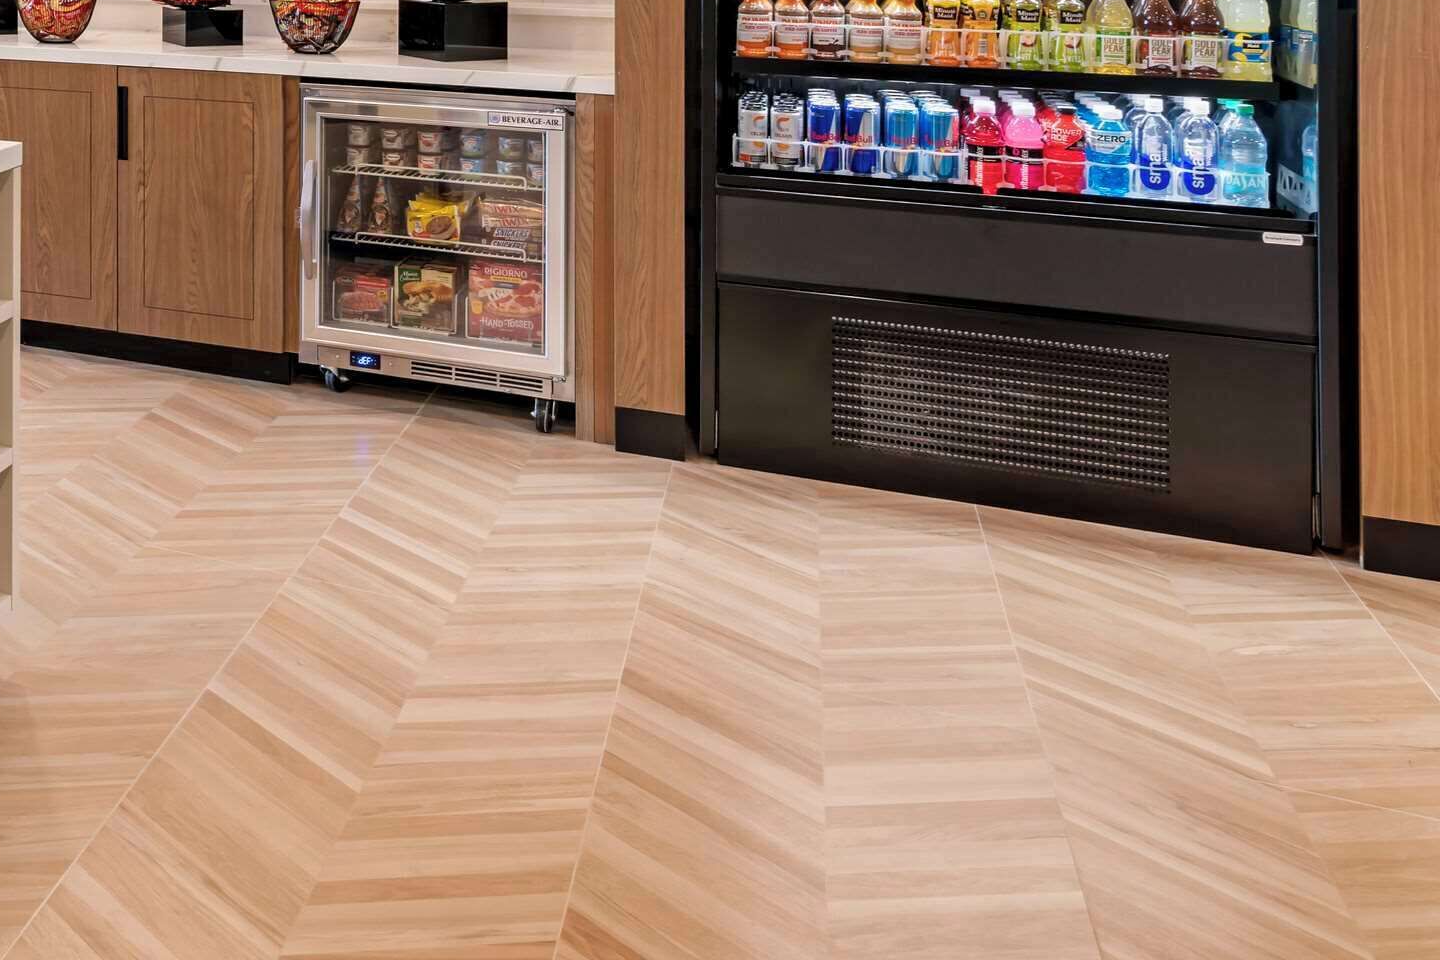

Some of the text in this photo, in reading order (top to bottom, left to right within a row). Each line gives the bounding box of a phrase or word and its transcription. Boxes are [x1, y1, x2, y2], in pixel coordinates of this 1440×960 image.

[1195, 40, 1216, 48] GOLD
[1152, 47, 1171, 55] PEAK
[1195, 48, 1215, 56] PEAK
[502, 115, 559, 126] BEVERAGE-AIR
[1051, 128, 1082, 136] POWER
[1096, 134, 1127, 143] ZERO
[495, 229, 529, 239] SNICKERS
[484, 267, 528, 279] DIGIORNO
